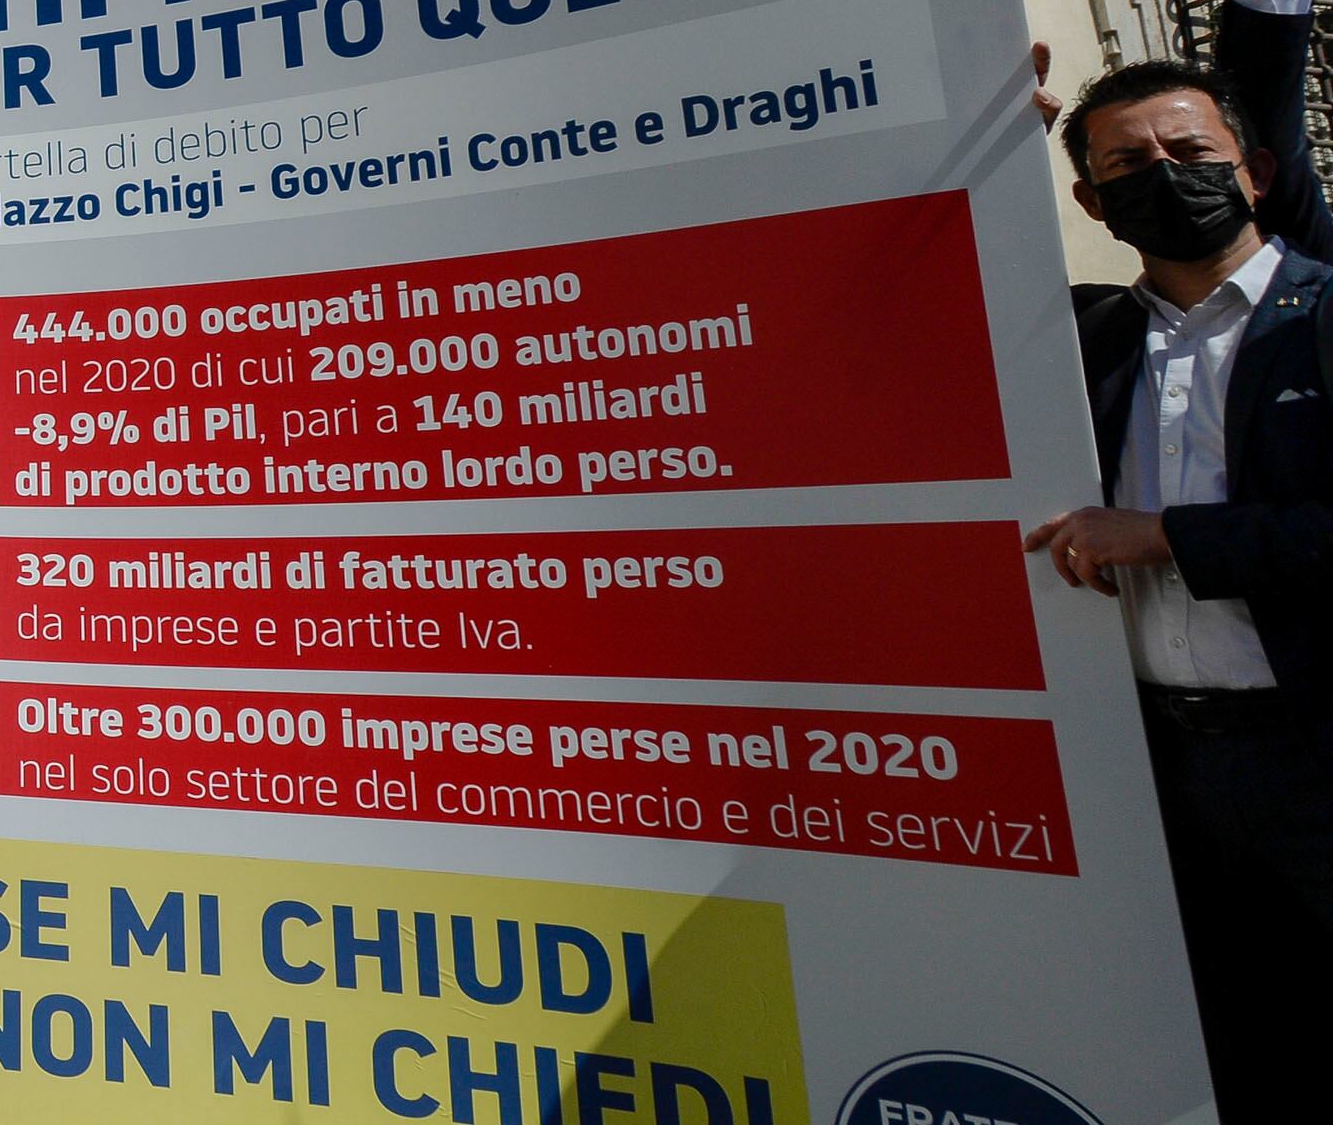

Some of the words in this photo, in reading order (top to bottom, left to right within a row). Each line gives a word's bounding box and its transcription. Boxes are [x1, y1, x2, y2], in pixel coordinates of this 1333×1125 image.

[104, 132, 136, 171] di
[153, 118, 282, 164] debito
[300, 104, 369, 154] per
[114, 169, 224, 219] Chigi
[270, 136, 452, 199] Governi
[467, 114, 618, 173] Conte
[634, 110, 664, 145] e
[681, 58, 879, 139] Draghi
[13, 304, 187, 344] 444.000
[200, 283, 385, 336] occupati
[397, 281, 439, 319] in
[453, 271, 582, 314] meno
[15, 360, 68, 395] nel
[82, 357, 175, 393] 2020
[191, 352, 223, 388] di
[239, 348, 294, 385] cui
[309, 332, 499, 381] 209.000
[514, 303, 753, 366] autonomi
[14, 409, 140, 451] -8,9%
[153, 405, 190, 443] di
[204, 403, 266, 445] Pil,
[282, 398, 359, 447] pari
[376, 404, 398, 433] a
[413, 390, 503, 431] 140
[518, 371, 708, 426] miliardi
[14, 461, 51, 497] di
[65, 460, 251, 505] prodotto
[263, 456, 429, 495] interno
[441, 445, 564, 489] lordo
[577, 443, 734, 493] perso.
[15, 552, 94, 589] 320
[108, 552, 271, 590] miliardi
[285, 552, 327, 591] di
[339, 551, 567, 591] fatturato
[582, 553, 724, 599] perso
[16, 604, 64, 642] da
[79, 606, 239, 652] imprese
[254, 616, 278, 647] e
[294, 610, 441, 656] partite
[459, 613, 534, 652] Iva.
[17, 697, 124, 738] Oltre
[137, 704, 326, 747] 300.000
[341, 707, 534, 761] imprese
[550, 722, 691, 768] perse
[707, 725, 790, 771] nel
[805, 729, 959, 781] 2020
[19, 754, 75, 792] nel
[91, 758, 170, 799] solo
[186, 766, 338, 807] settore
[355, 769, 418, 812] del
[436, 781, 702, 832] commercio
[722, 800, 750, 835] e
[769, 793, 845, 843] dei
[869, 810, 1054, 863] servizi
[109, 886, 222, 976] MI
[261, 899, 654, 1024] CHIUDI
[211, 1009, 330, 1107] MI
[372, 1028, 774, 1125] CHIEDI
